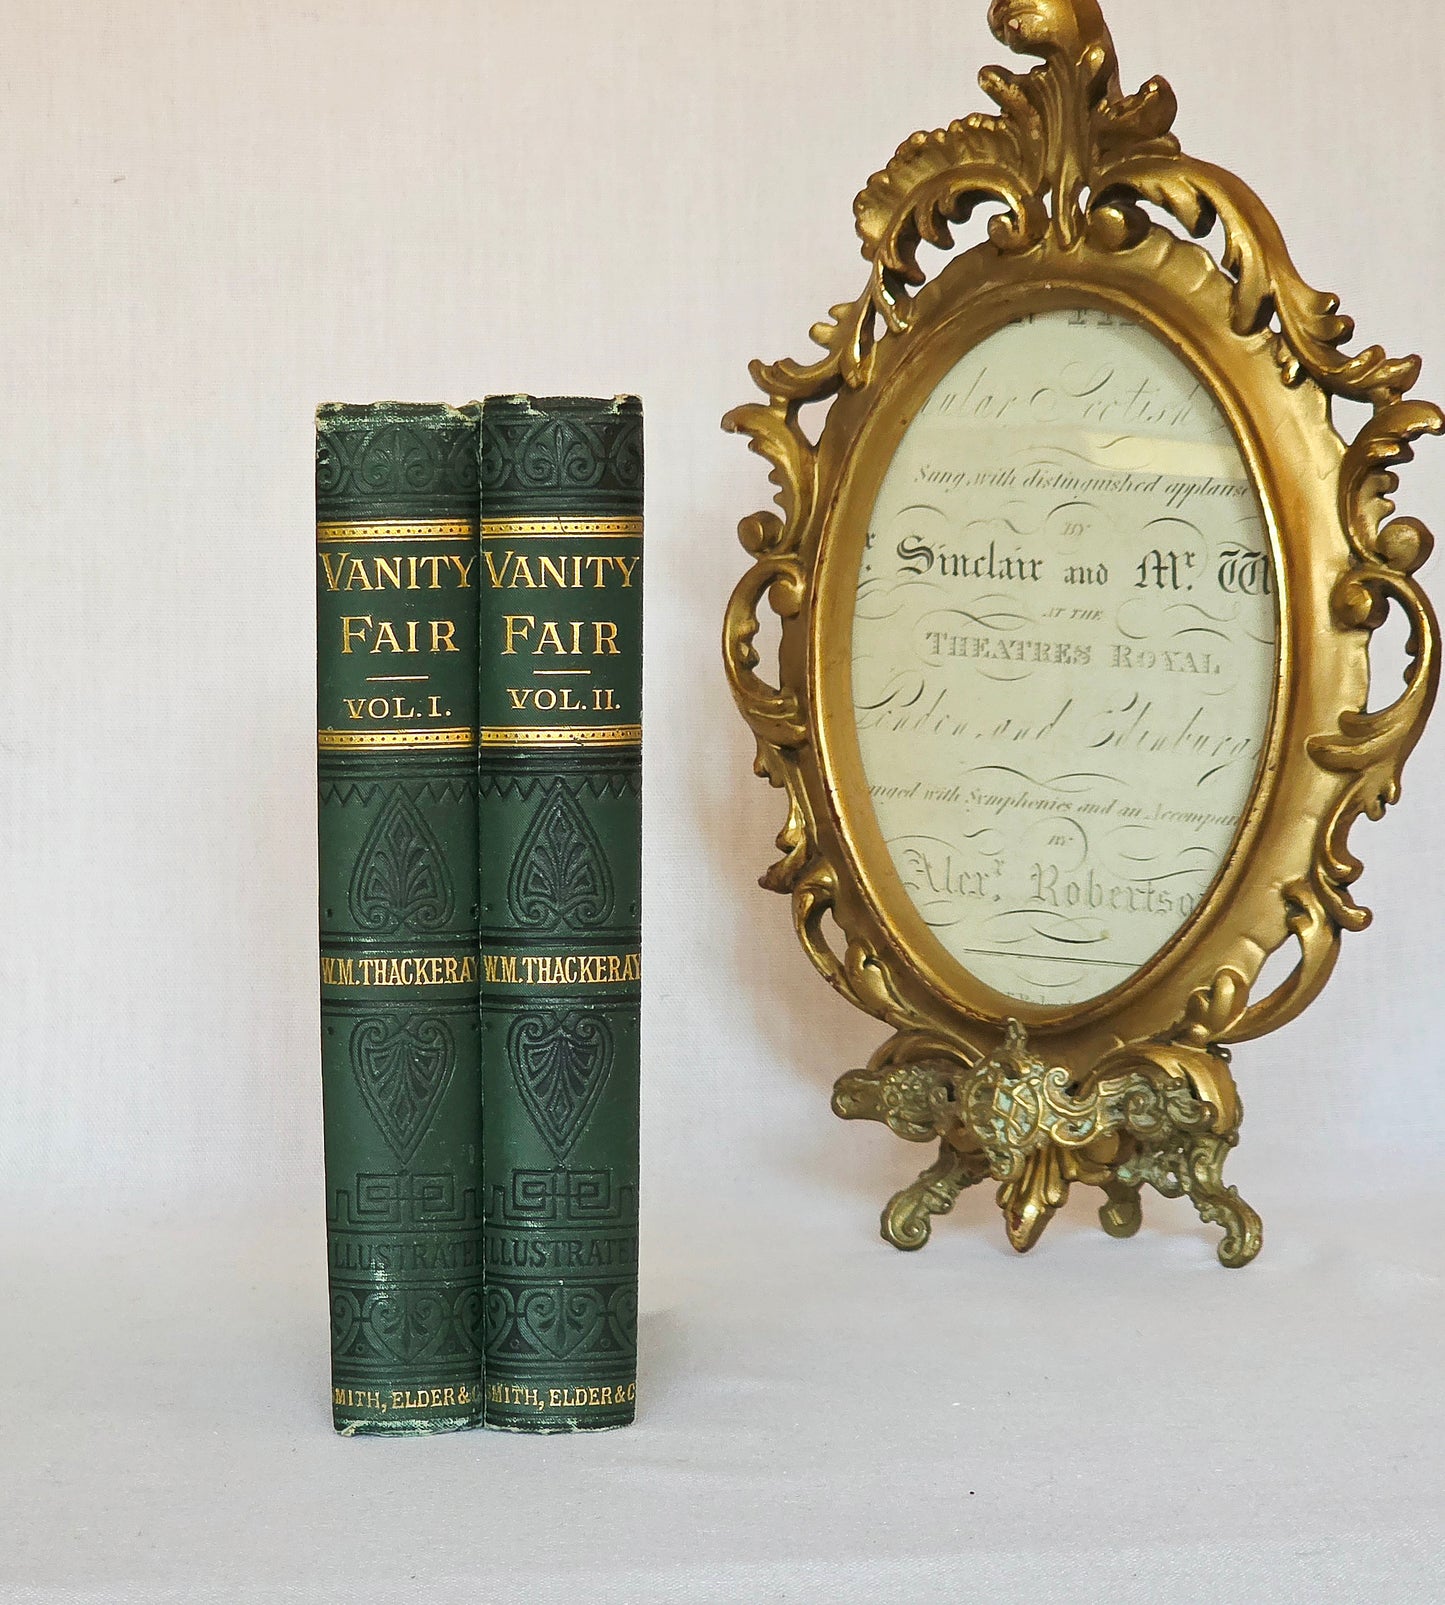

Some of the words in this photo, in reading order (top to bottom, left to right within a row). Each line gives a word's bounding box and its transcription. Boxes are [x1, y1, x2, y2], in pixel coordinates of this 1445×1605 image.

[974, 467, 1017, 487] with
[1022, 468, 1164, 497] distinguished
[319, 551, 477, 591] VANITY
[482, 549, 640, 588] VANITY
[896, 535, 1043, 582] Sinclair
[1063, 563, 1109, 586] and
[340, 614, 460, 654] FAIR
[501, 614, 621, 655] FAIR
[924, 631, 1093, 666] THEATRES
[1111, 643, 1221, 675] ROYAL
[991, 698, 1073, 741] and
[1077, 799, 1119, 816] and
